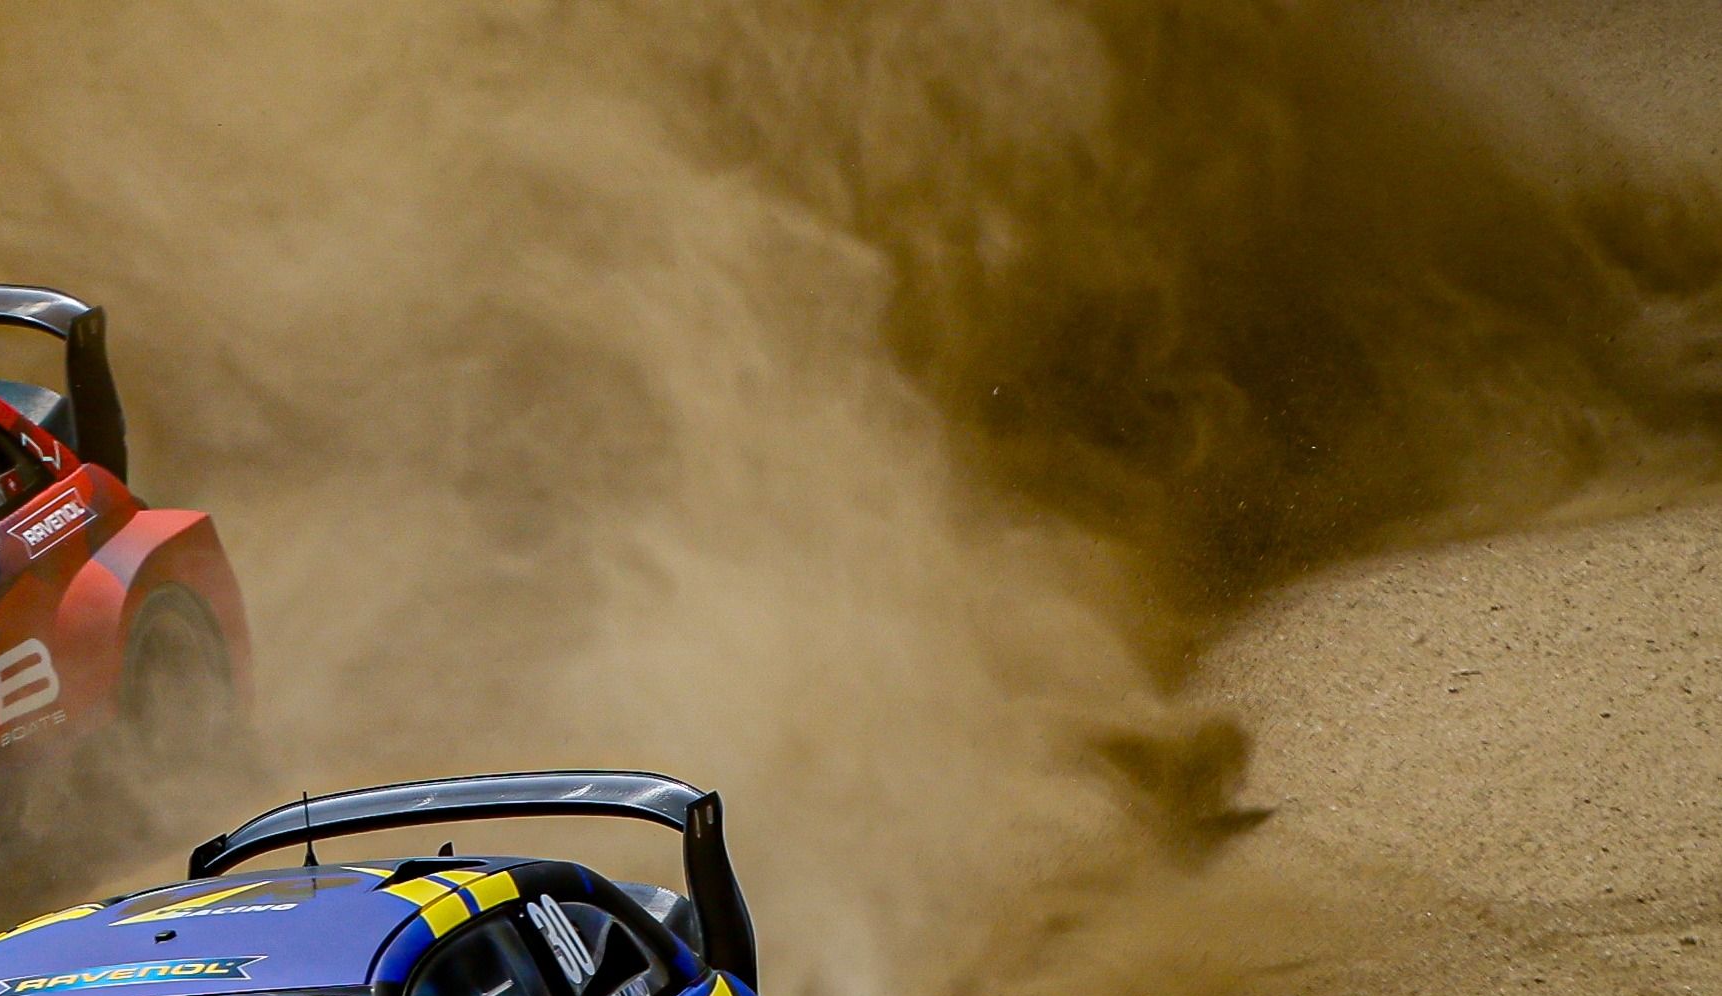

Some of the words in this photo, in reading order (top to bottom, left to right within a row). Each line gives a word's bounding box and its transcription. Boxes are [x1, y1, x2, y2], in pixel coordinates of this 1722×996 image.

[22, 501, 86, 546] RAVENOL
[526, 893, 596, 984] 30
[14, 961, 236, 994] RAVENOL
